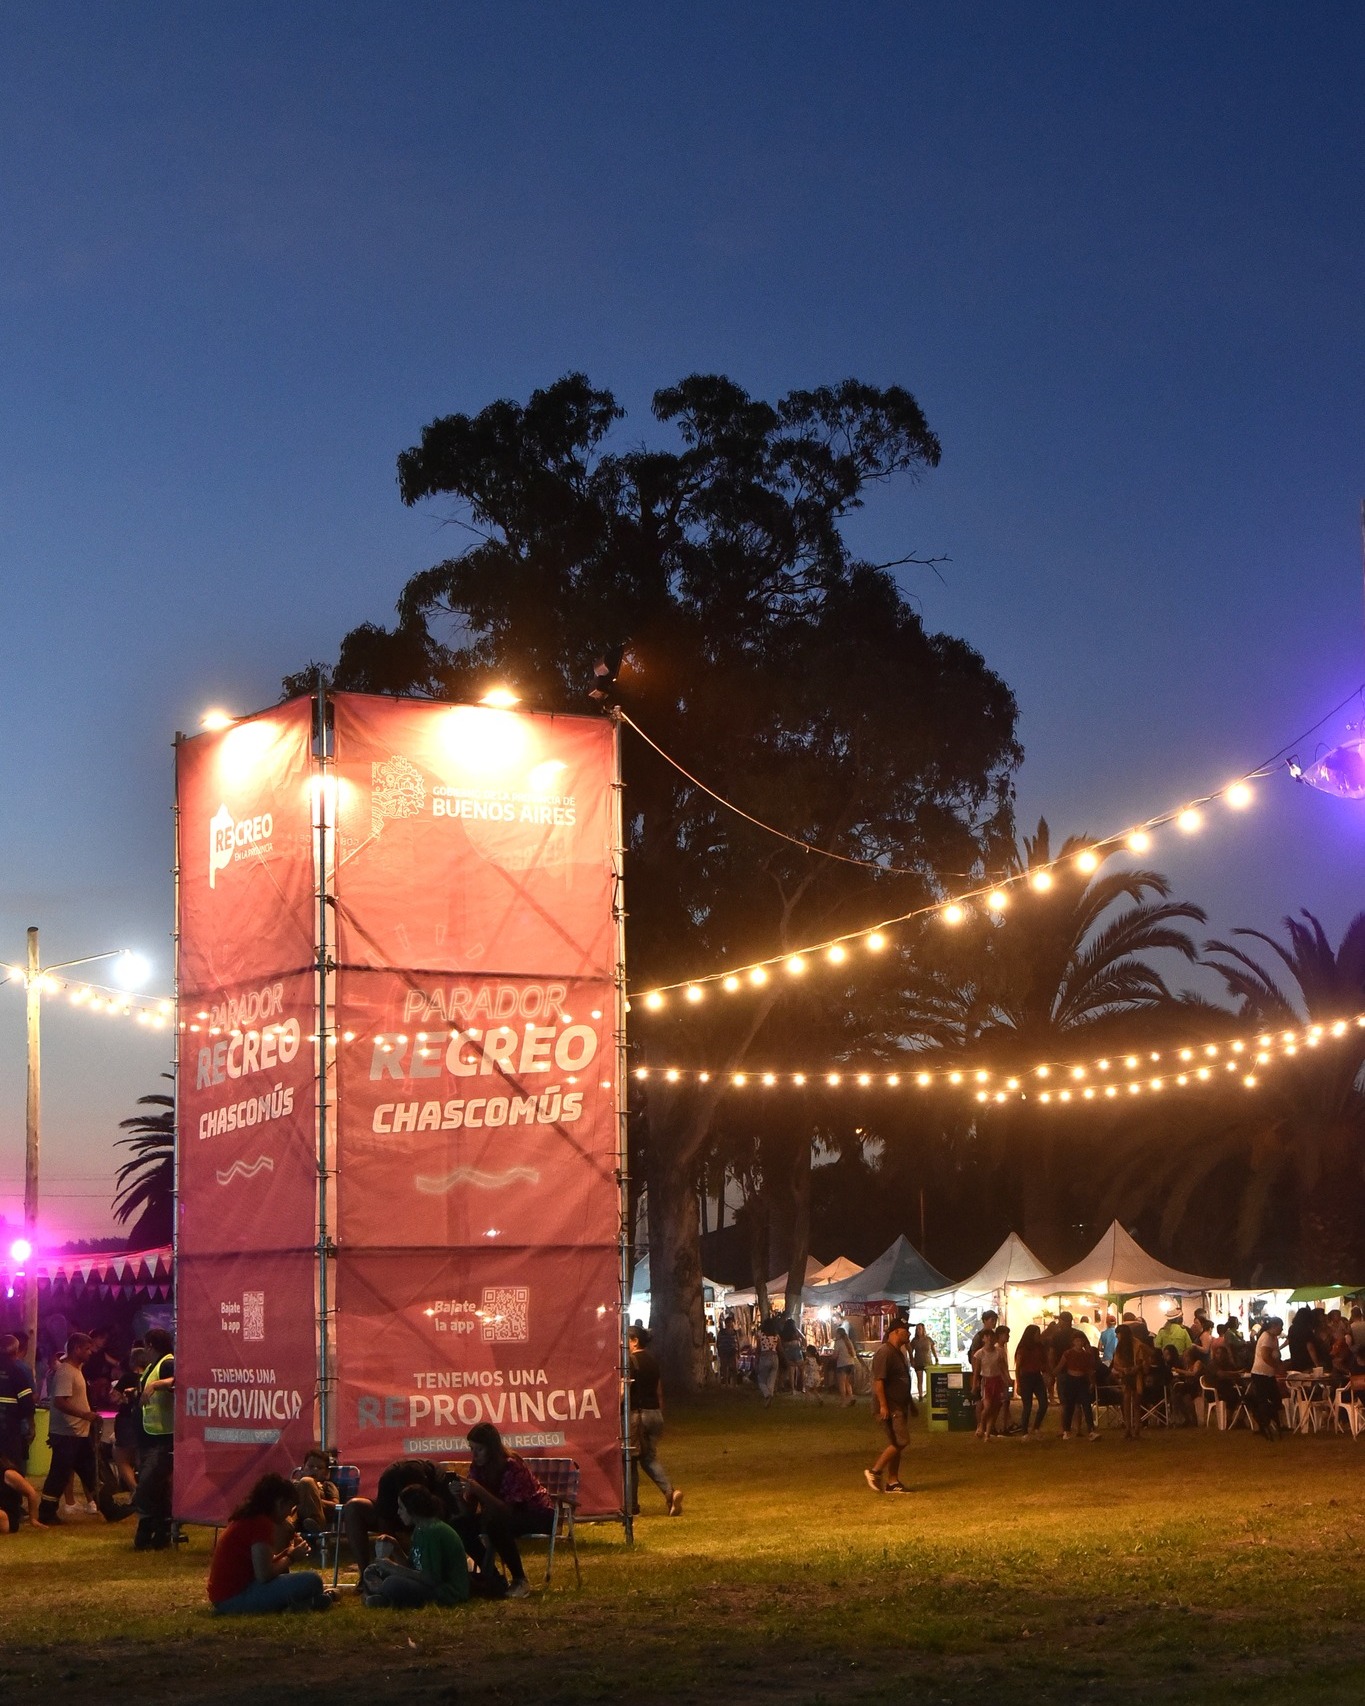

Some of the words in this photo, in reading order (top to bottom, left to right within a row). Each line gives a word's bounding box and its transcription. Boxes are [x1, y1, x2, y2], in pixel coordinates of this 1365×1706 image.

[432, 798, 516, 822] BUENOS
[519, 804, 577, 826] AIRES
[563, 796, 576, 806] DE
[215, 813, 273, 853] RECREO
[209, 982, 284, 1037] PARADOR
[403, 984, 567, 1023] PARADOR
[196, 1017, 300, 1090] RECREO
[369, 1024, 598, 1081] RECREO
[200, 1082, 294, 1140] CHASCOMÚS
[372, 1085, 584, 1133] CHASCOMÚS
[220, 1300, 241, 1317] Bajate
[434, 1299, 476, 1316] Bajate
[221, 1319, 228, 1331] la
[228, 1321, 241, 1333] app
[434, 1318, 447, 1331] la
[450, 1320, 475, 1334] app
[211, 1369, 254, 1384] TENEMOS
[256, 1369, 276, 1384] UNA
[414, 1370, 504, 1389] TENEMOS
[509, 1369, 548, 1386] UNA
[186, 1387, 302, 1420] REPROVINCIA
[357, 1388, 602, 1430] REPROVINCIA
[409, 1438, 472, 1452] DISFRUTA
[515, 1434, 560, 1447] RECREO
